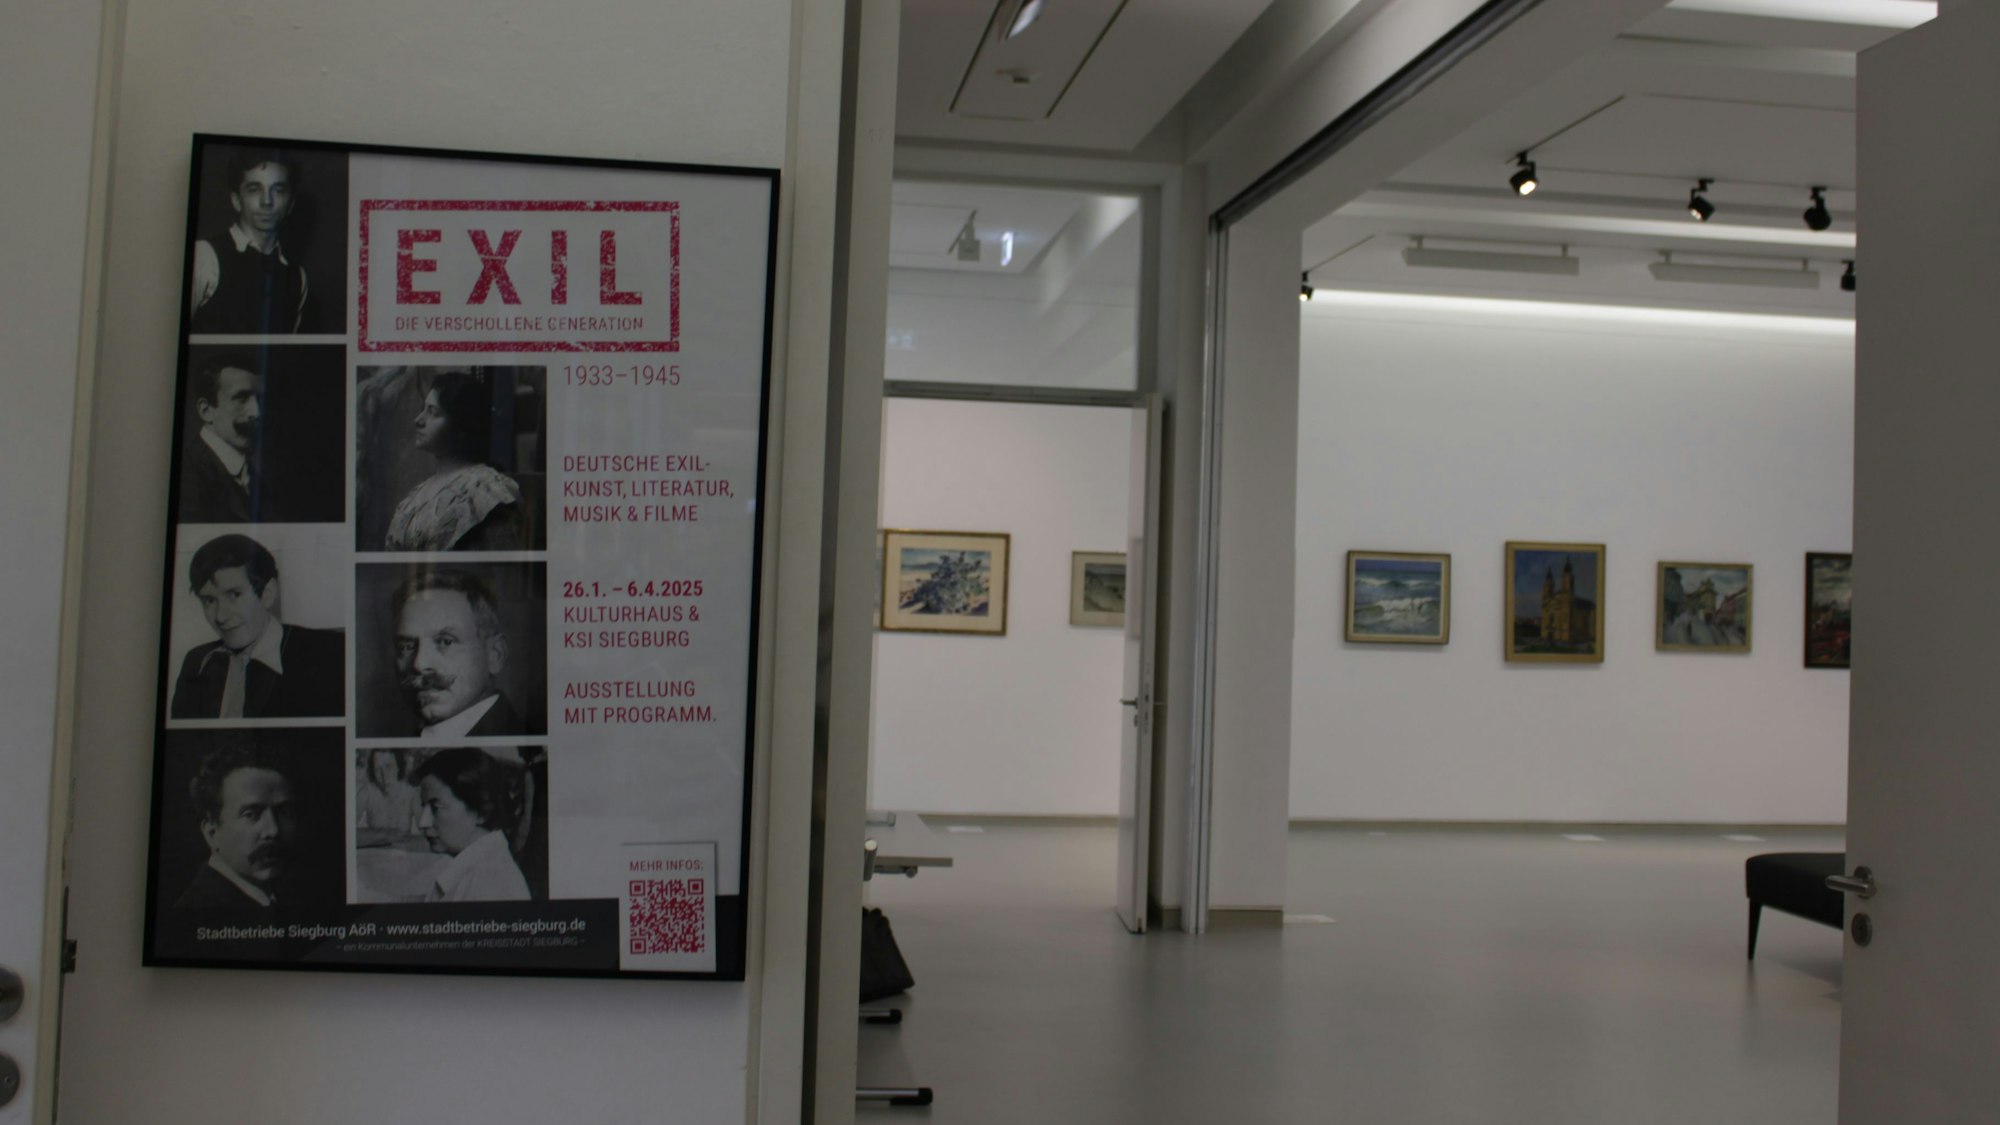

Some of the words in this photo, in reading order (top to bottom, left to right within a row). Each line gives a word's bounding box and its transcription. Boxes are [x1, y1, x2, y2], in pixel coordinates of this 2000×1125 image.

[395, 228, 643, 306] EXIL
[395, 317, 419, 331] DIE
[424, 316, 543, 332] VERSCHOLLENE
[547, 316, 644, 332] GENERATION
[562, 364, 682, 387] 1933–1945
[563, 455, 660, 473] DEUTSCHE
[666, 454, 711, 472] EXIL-
[563, 480, 627, 500] KUNST,
[632, 479, 735, 499] LITERATUR,
[563, 505, 623, 523] MUSIK
[627, 505, 639, 522] &
[644, 505, 699, 522] FILME
[563, 581, 607, 599] 26.1.
[627, 580, 704, 598] 6.4.2025
[563, 605, 684, 624] KULTURHAUS
[688, 604, 700, 622] &
[564, 631, 593, 649] KSI
[599, 630, 691, 648] SIEGBURG
[564, 681, 695, 699] AUSSTELLUNG
[564, 707, 598, 725] MIT
[603, 705, 718, 724] PROGRAMM.
[629, 860, 662, 872] MEHR
[196, 926, 285, 940] Stadtbetriebe
[288, 924, 346, 941] Siegburg
[349, 923, 376, 936] AöR
[387, 918, 586, 936] www.stadtbetriebe-siegburg.de
